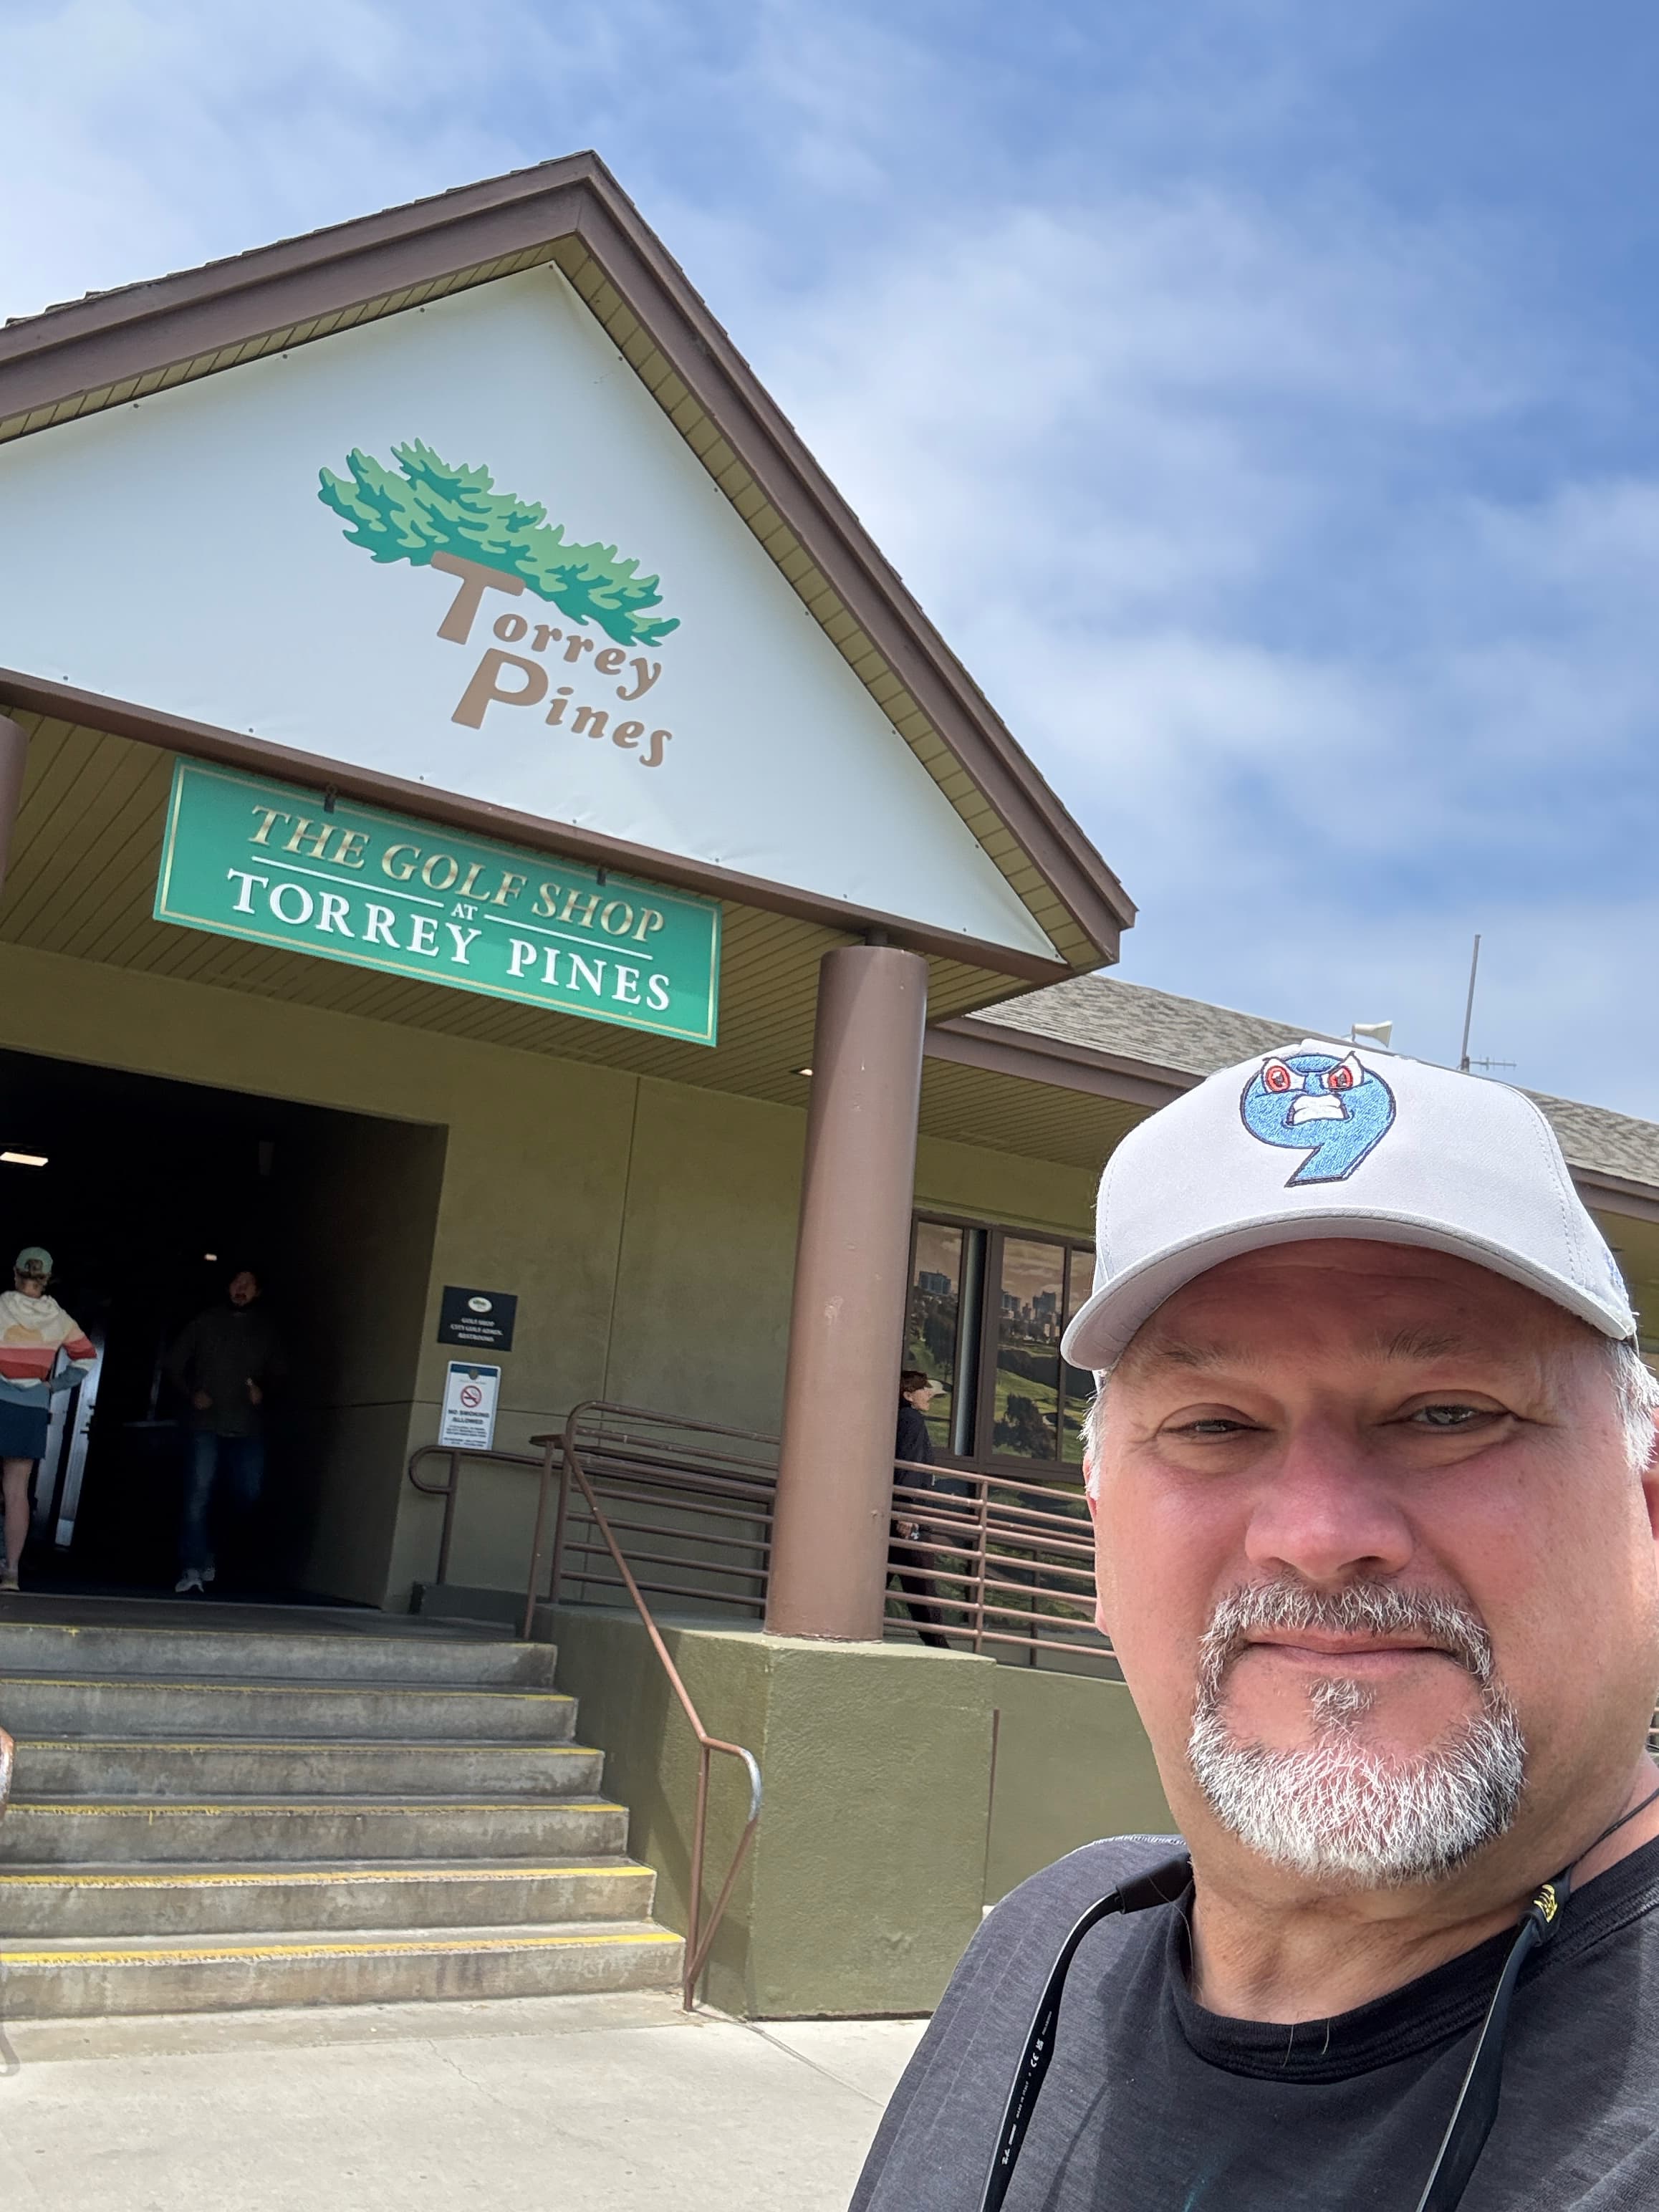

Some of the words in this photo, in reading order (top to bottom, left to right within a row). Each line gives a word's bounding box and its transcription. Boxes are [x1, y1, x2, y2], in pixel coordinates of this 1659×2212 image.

[431, 550, 661, 701] Torrey
[451, 648, 672, 767] Pines
[226, 867, 482, 965] TORREY
[506, 938, 670, 1011] PINES
[249, 804, 369, 869] THE
[382, 843, 527, 907] GOLF
[532, 883, 665, 943] SHOP
[451, 902, 479, 921] AT
